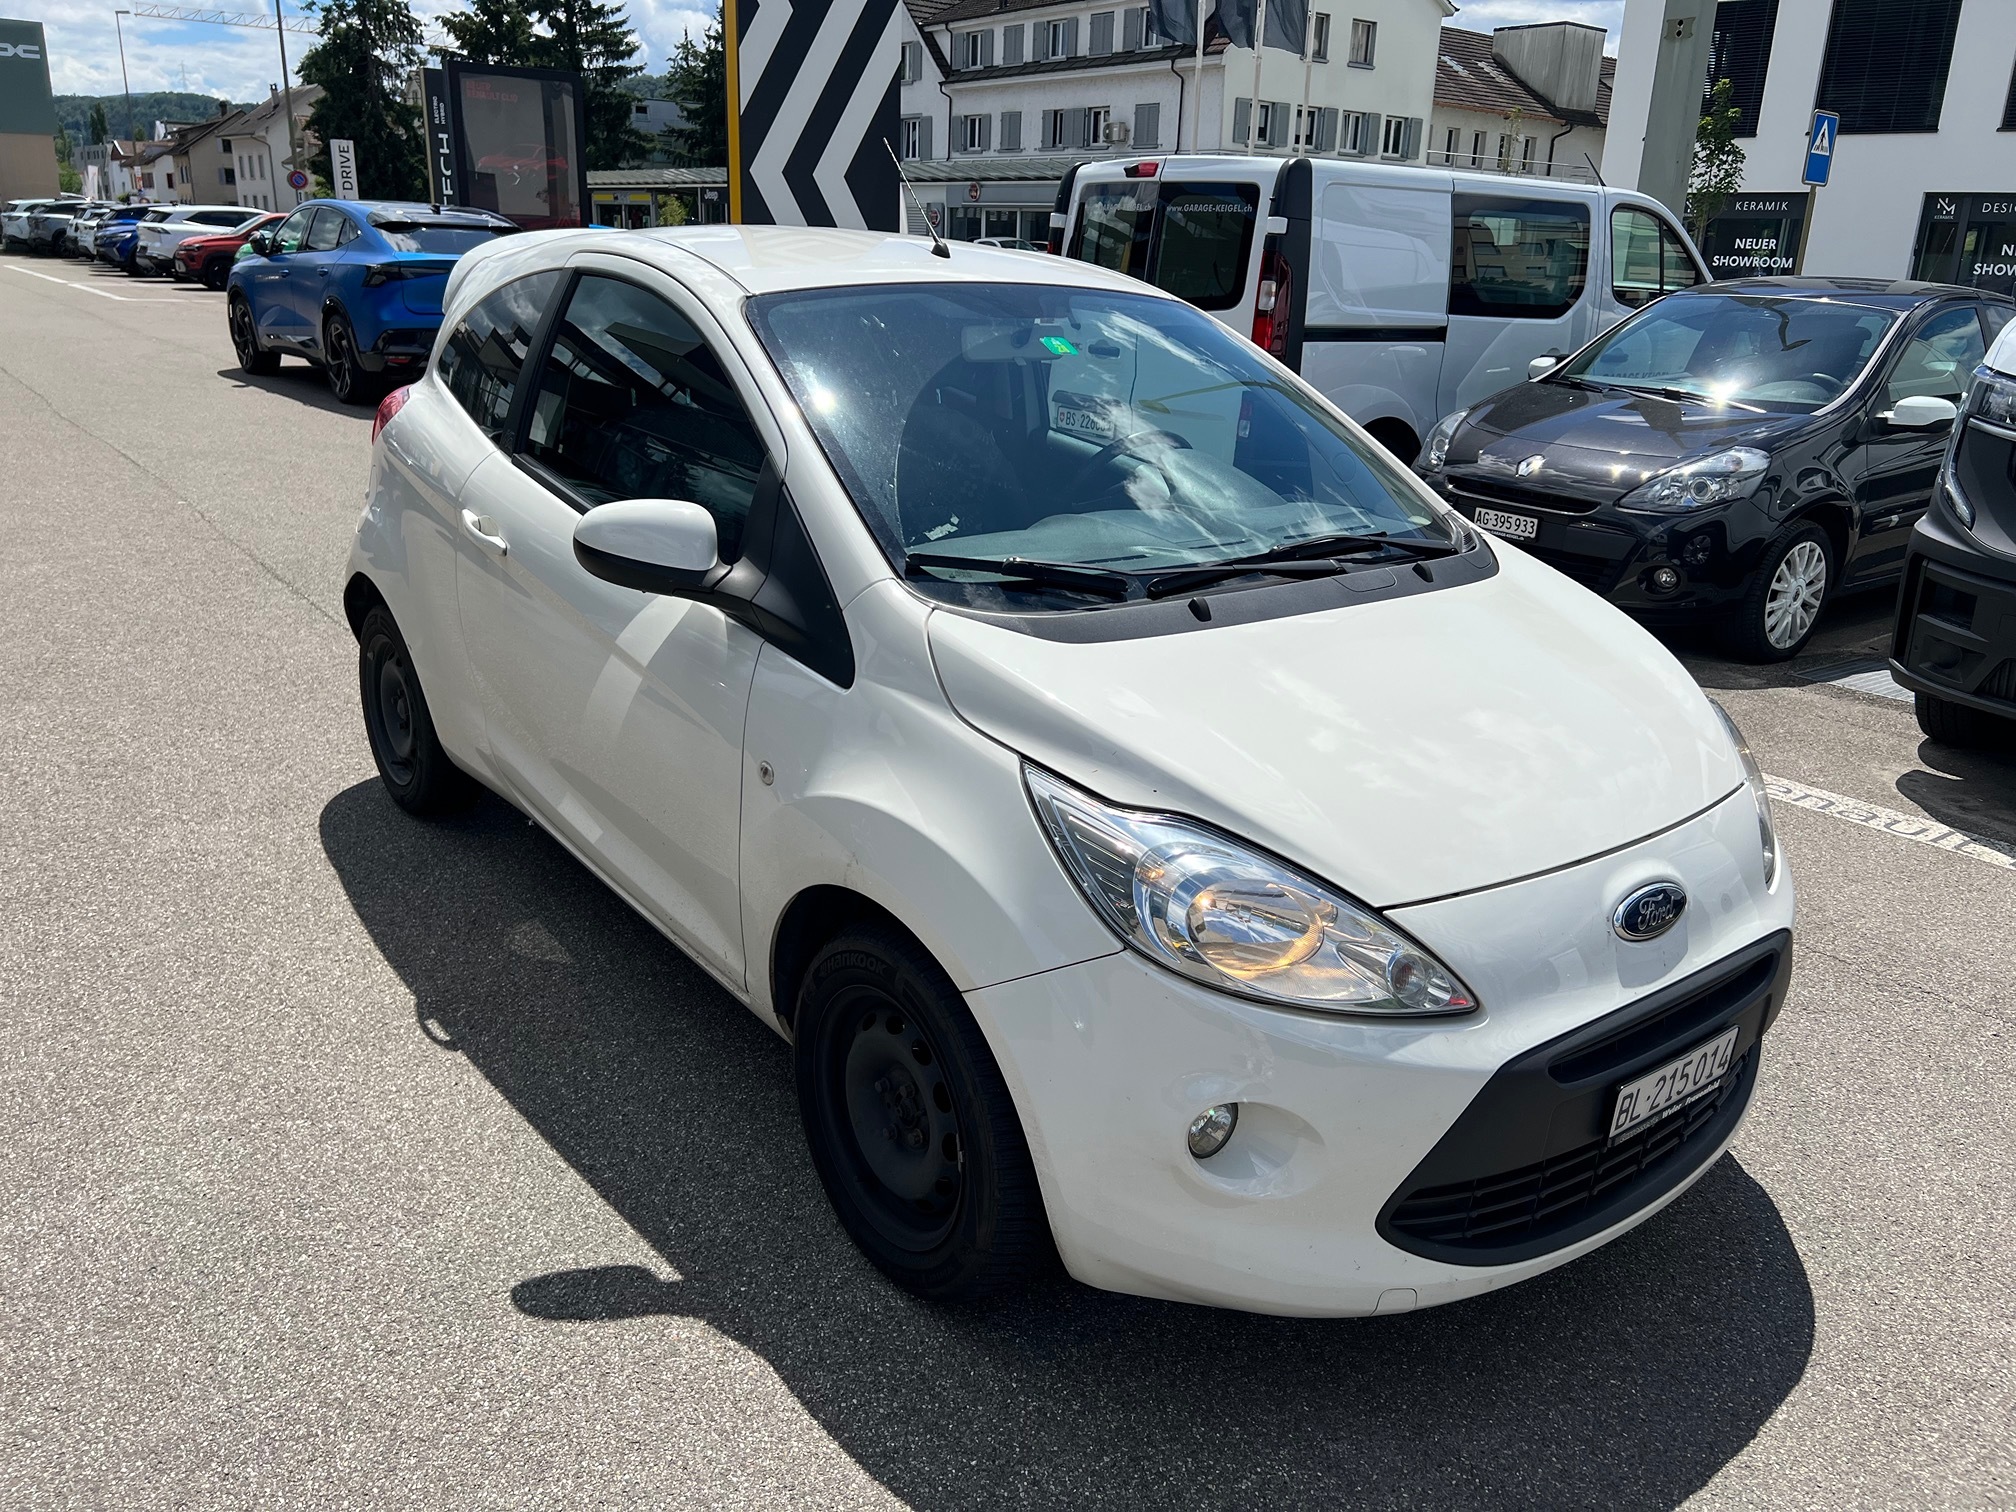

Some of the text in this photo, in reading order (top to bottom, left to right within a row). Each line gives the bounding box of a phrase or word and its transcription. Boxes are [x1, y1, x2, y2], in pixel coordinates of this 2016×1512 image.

[338, 144, 354, 191] DRIVE
[704, 188, 719, 201] Jeep
[1166, 203, 1253, 213] www.GARAGE-KEIGEL.ch
[1735, 201, 1789, 211] KERAMIK
[1982, 202, 2016, 213] DESI
[1734, 238, 1777, 250] NEUER
[1712, 255, 1793, 268] SHOWROOM
[1765, 783, 1974, 855] enault
[1637, 893, 1676, 931] Ford
